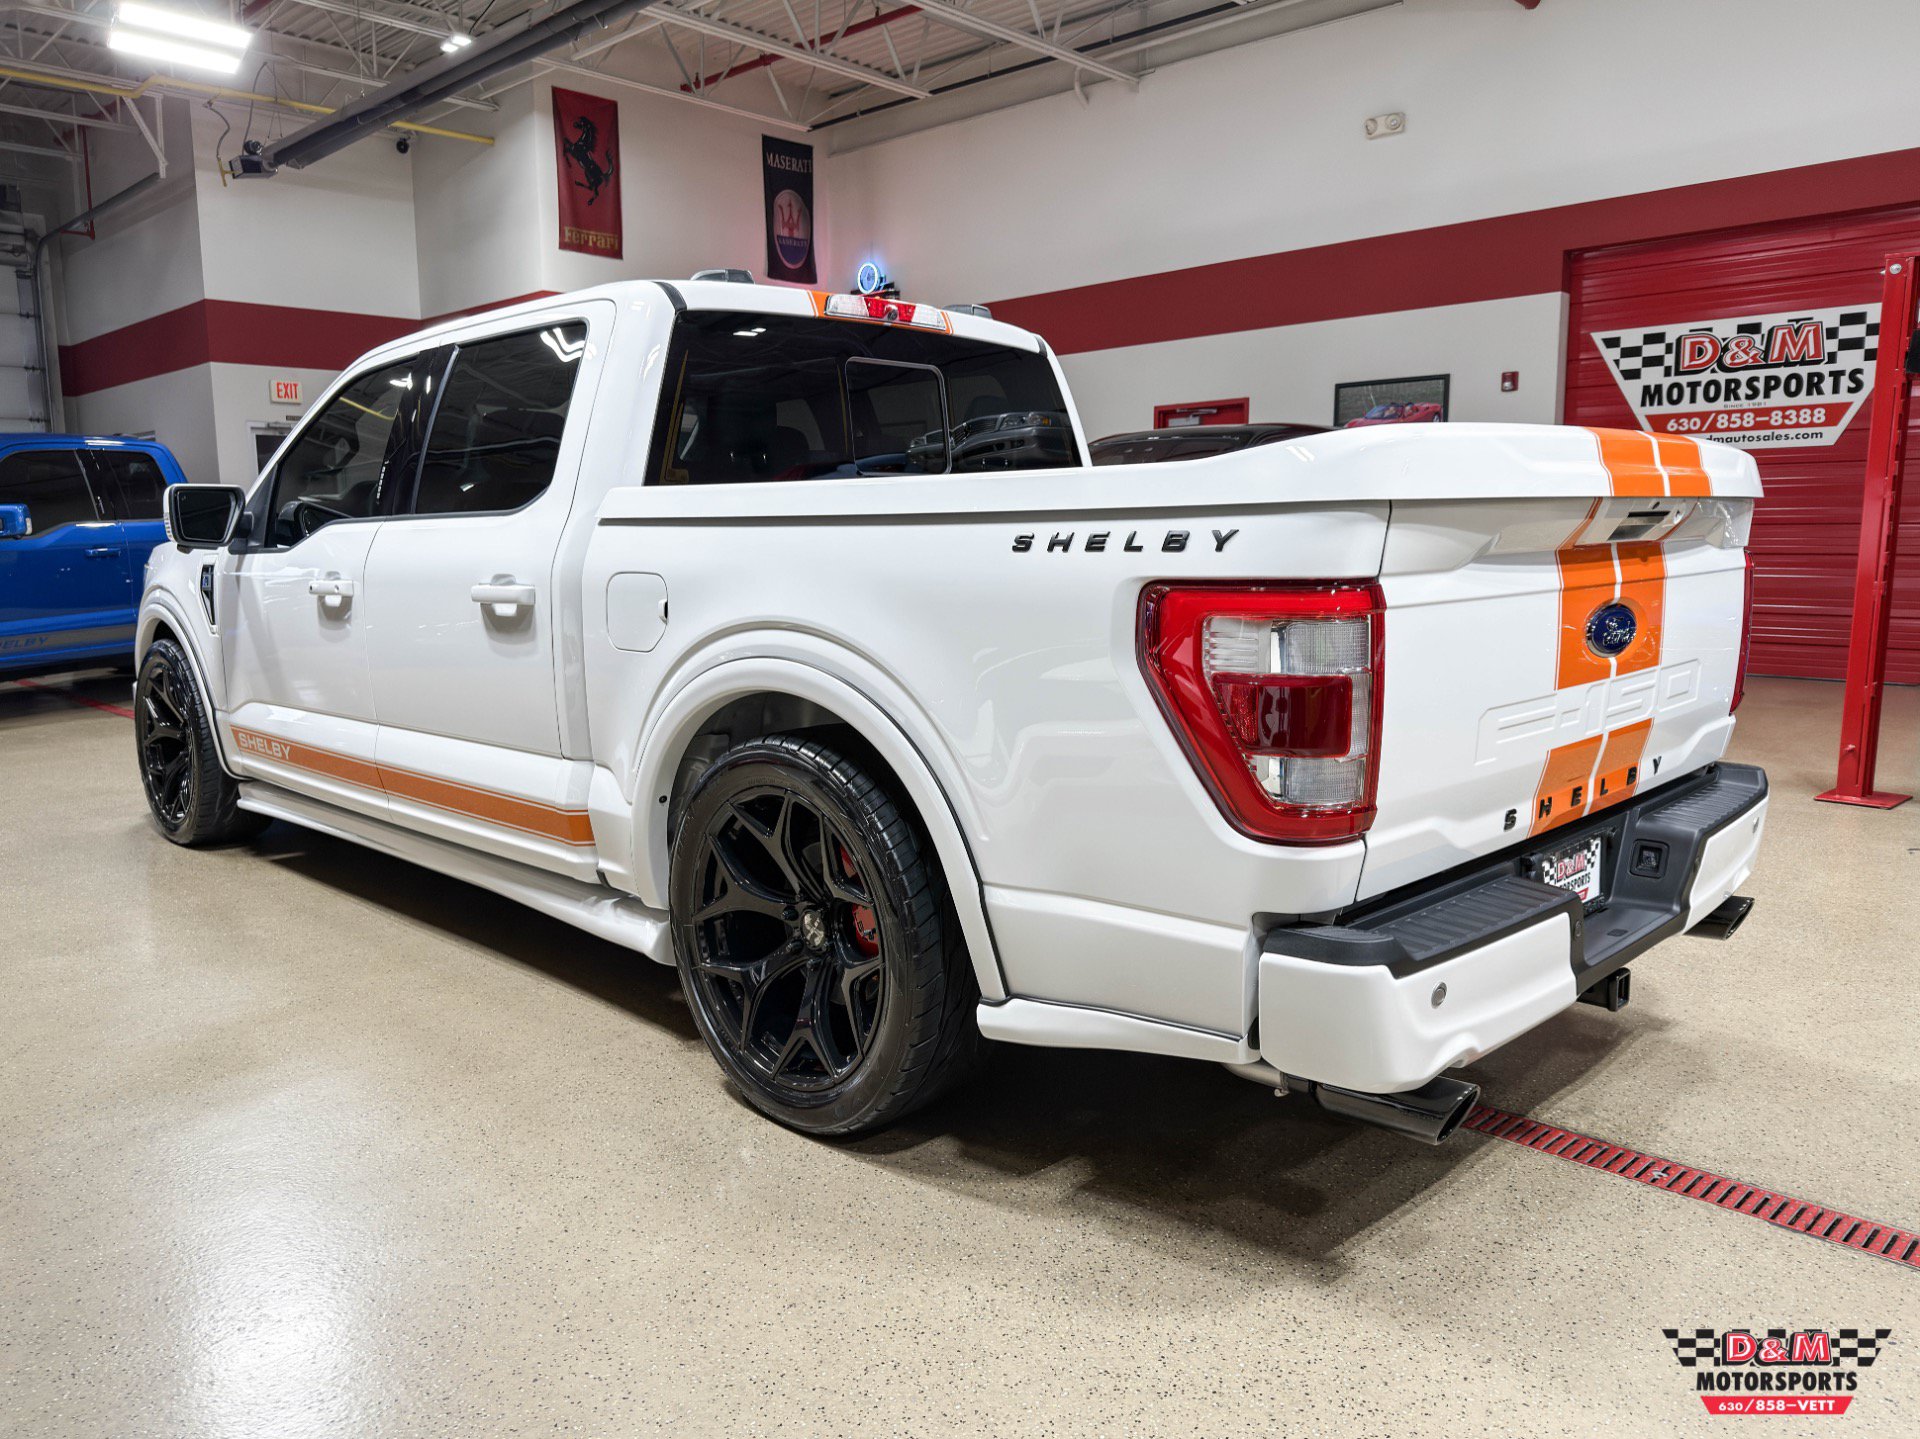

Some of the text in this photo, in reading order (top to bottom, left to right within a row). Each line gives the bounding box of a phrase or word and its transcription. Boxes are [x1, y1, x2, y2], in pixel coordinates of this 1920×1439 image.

[766, 152, 812, 173] MASERATI
[564, 226, 619, 250] Ferrari
[1676, 321, 1825, 375] D&M
[276, 382, 299, 399] EXIT
[1641, 368, 1864, 407] MOTORSPORTS
[1666, 408, 1826, 432] 630/858-8388
[1012, 529, 1239, 552] SHELBY
[238, 732, 290, 760] SHELBY
[1503, 756, 1662, 831] SHELBY
[1557, 851, 1587, 882] D&M
